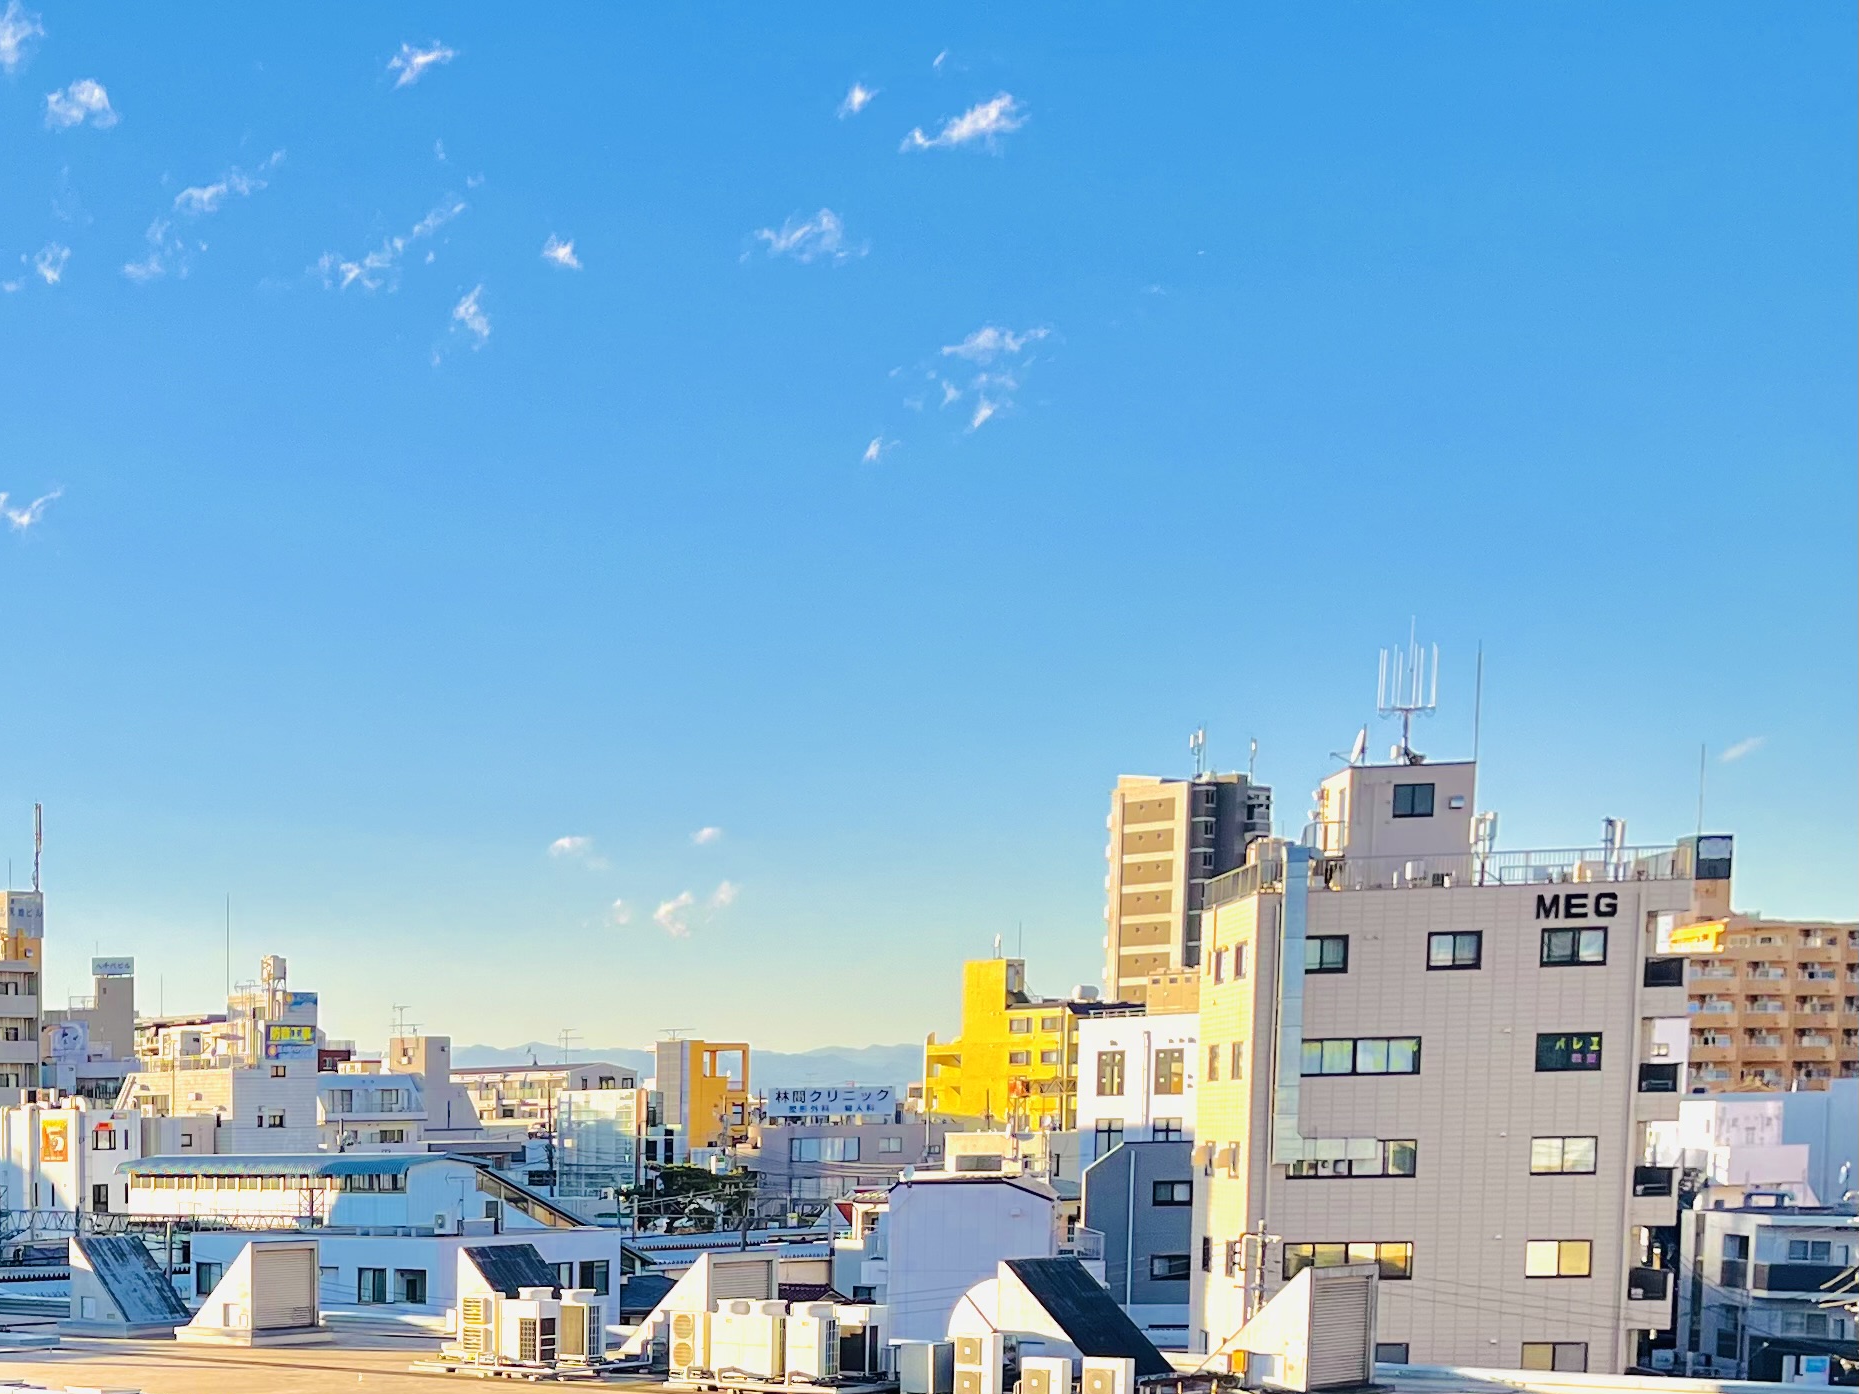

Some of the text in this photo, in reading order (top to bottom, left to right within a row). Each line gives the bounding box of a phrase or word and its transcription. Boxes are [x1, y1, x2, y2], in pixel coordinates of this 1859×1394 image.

[1535, 892, 1618, 919] MEG
[775, 1089, 890, 1104] 林間クリニック
